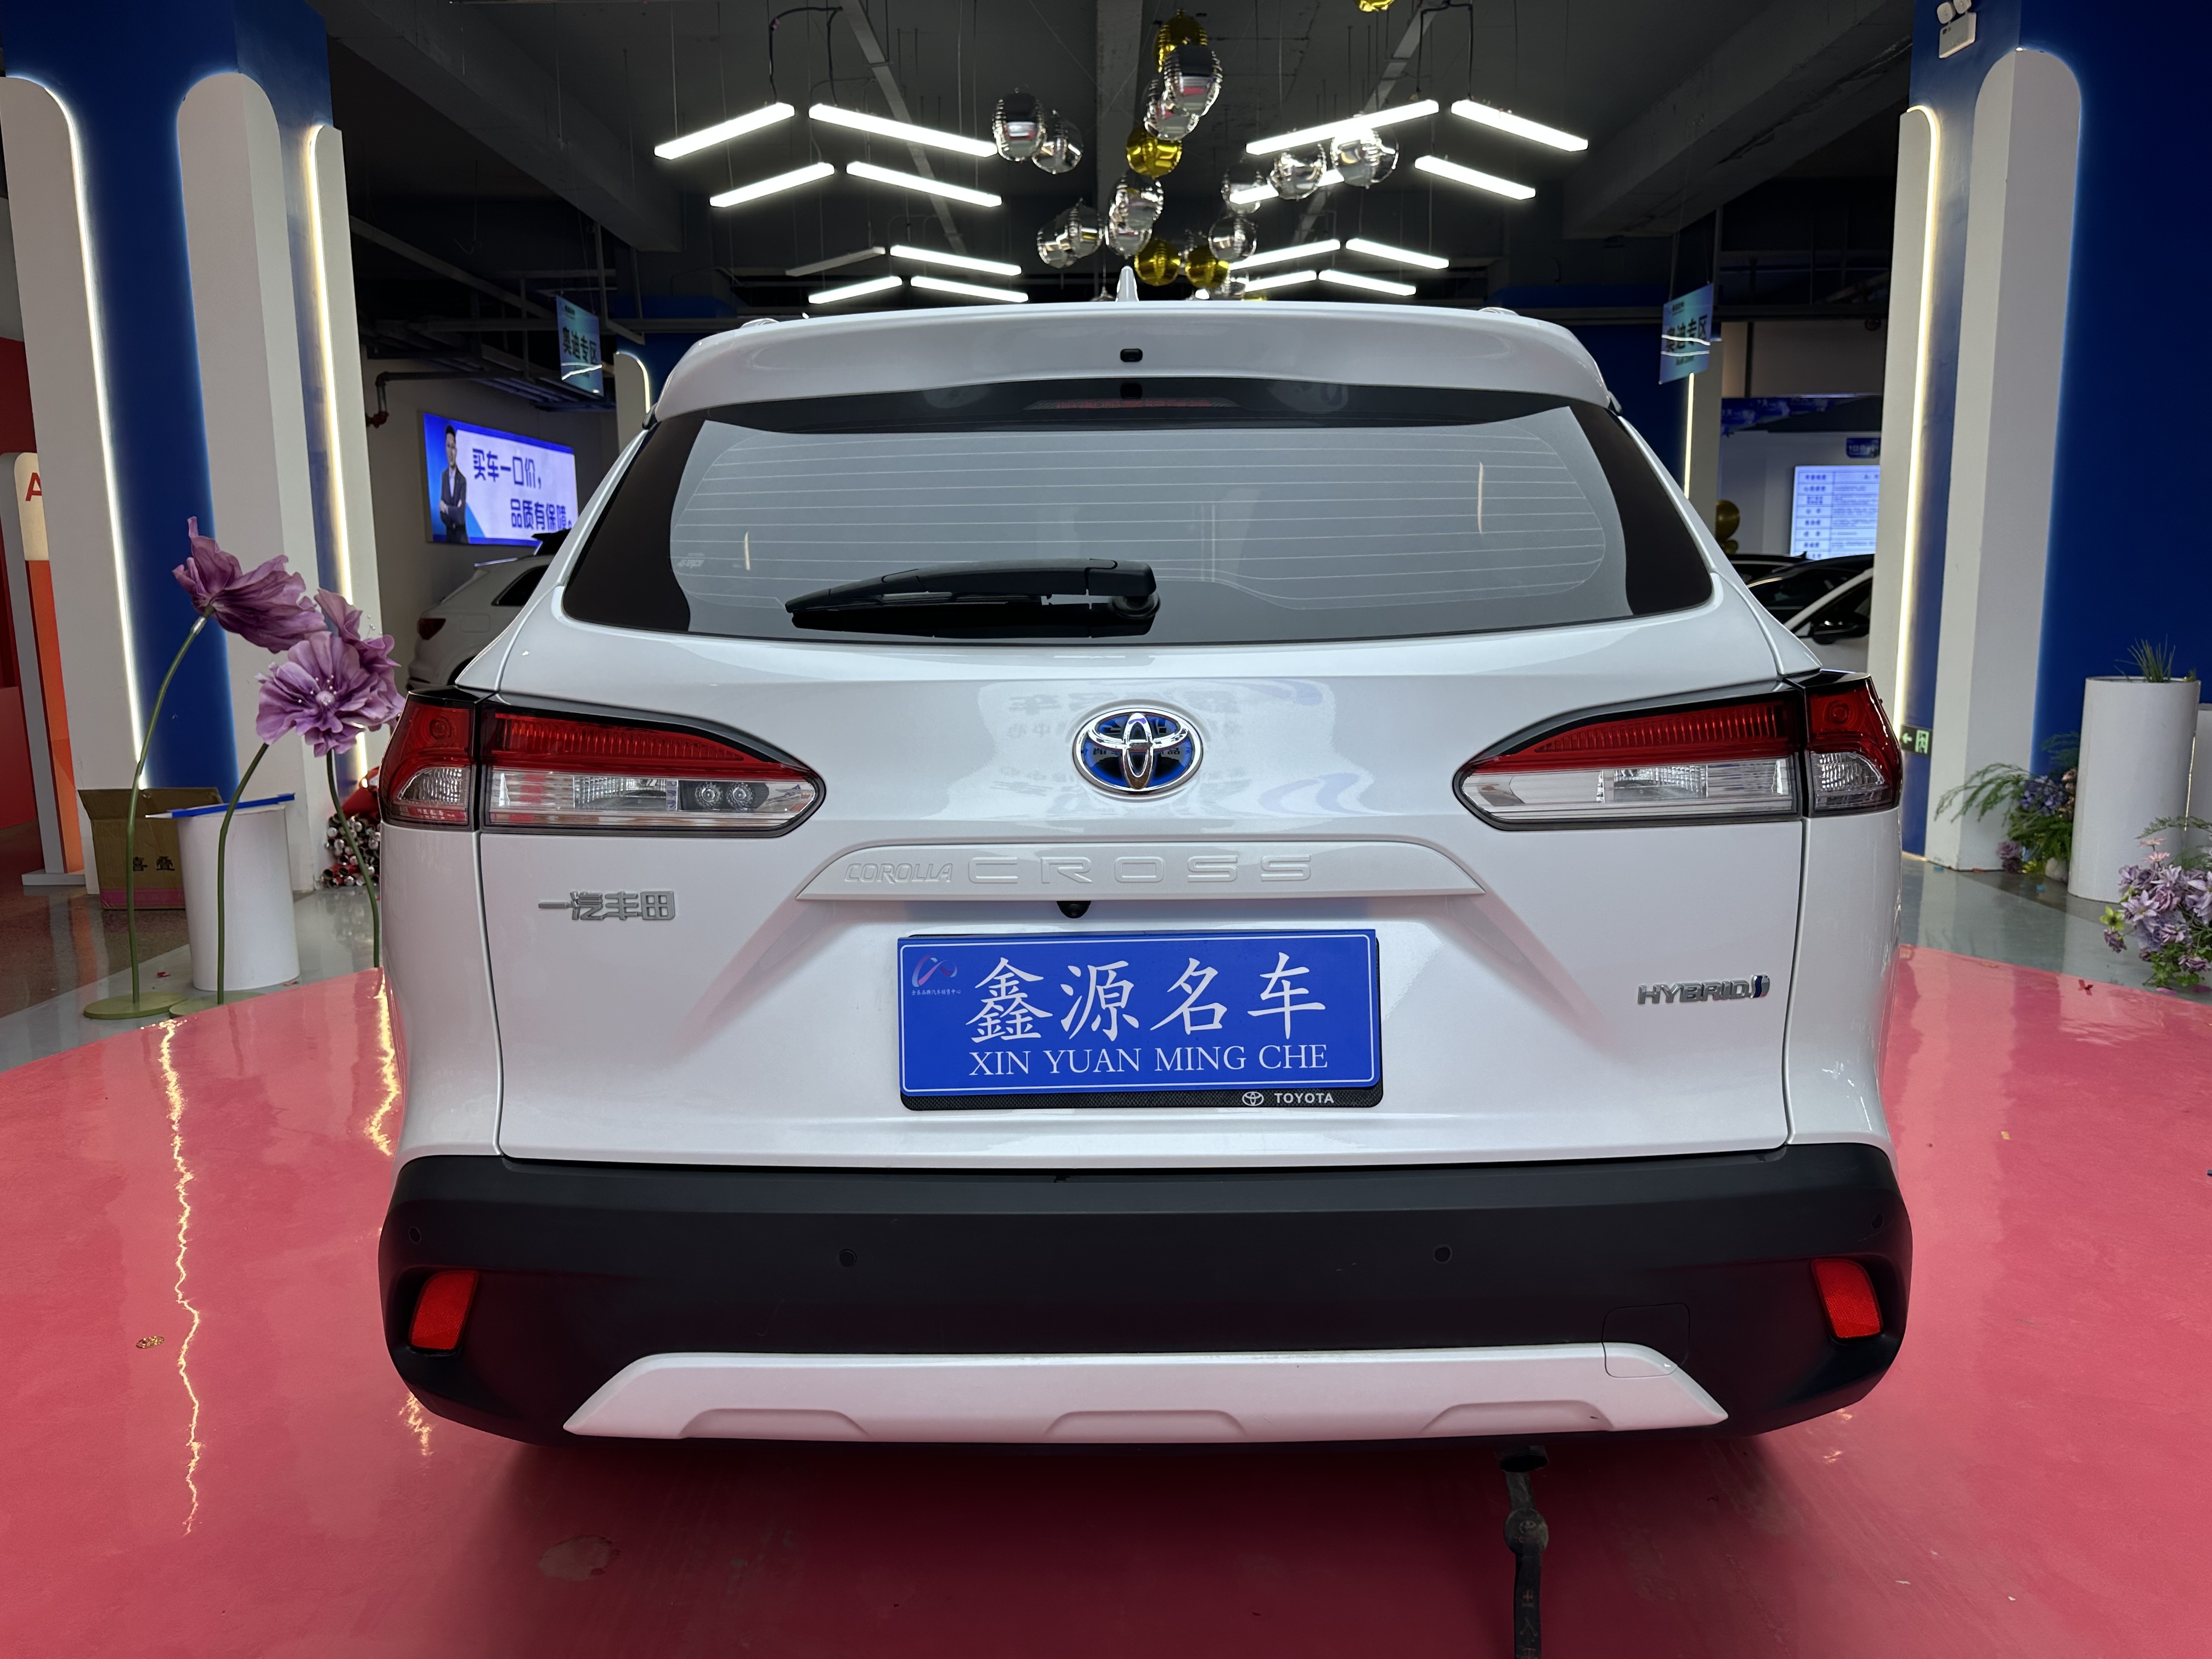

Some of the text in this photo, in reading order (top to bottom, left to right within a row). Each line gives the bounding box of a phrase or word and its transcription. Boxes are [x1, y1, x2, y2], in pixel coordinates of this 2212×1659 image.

[562, 326, 598, 364] 奥迪专区
[843, 854, 1312, 884] COROLLA CROSS
[538, 890, 675, 921] 一汽丰田
[966, 952, 1326, 1043] 鑫源名车
[1637, 979, 1750, 1005] HYBRID
[968, 1043, 1328, 1076] XIN YUAN MING CHE
[1273, 1092, 1335, 1104] TOYOTA
